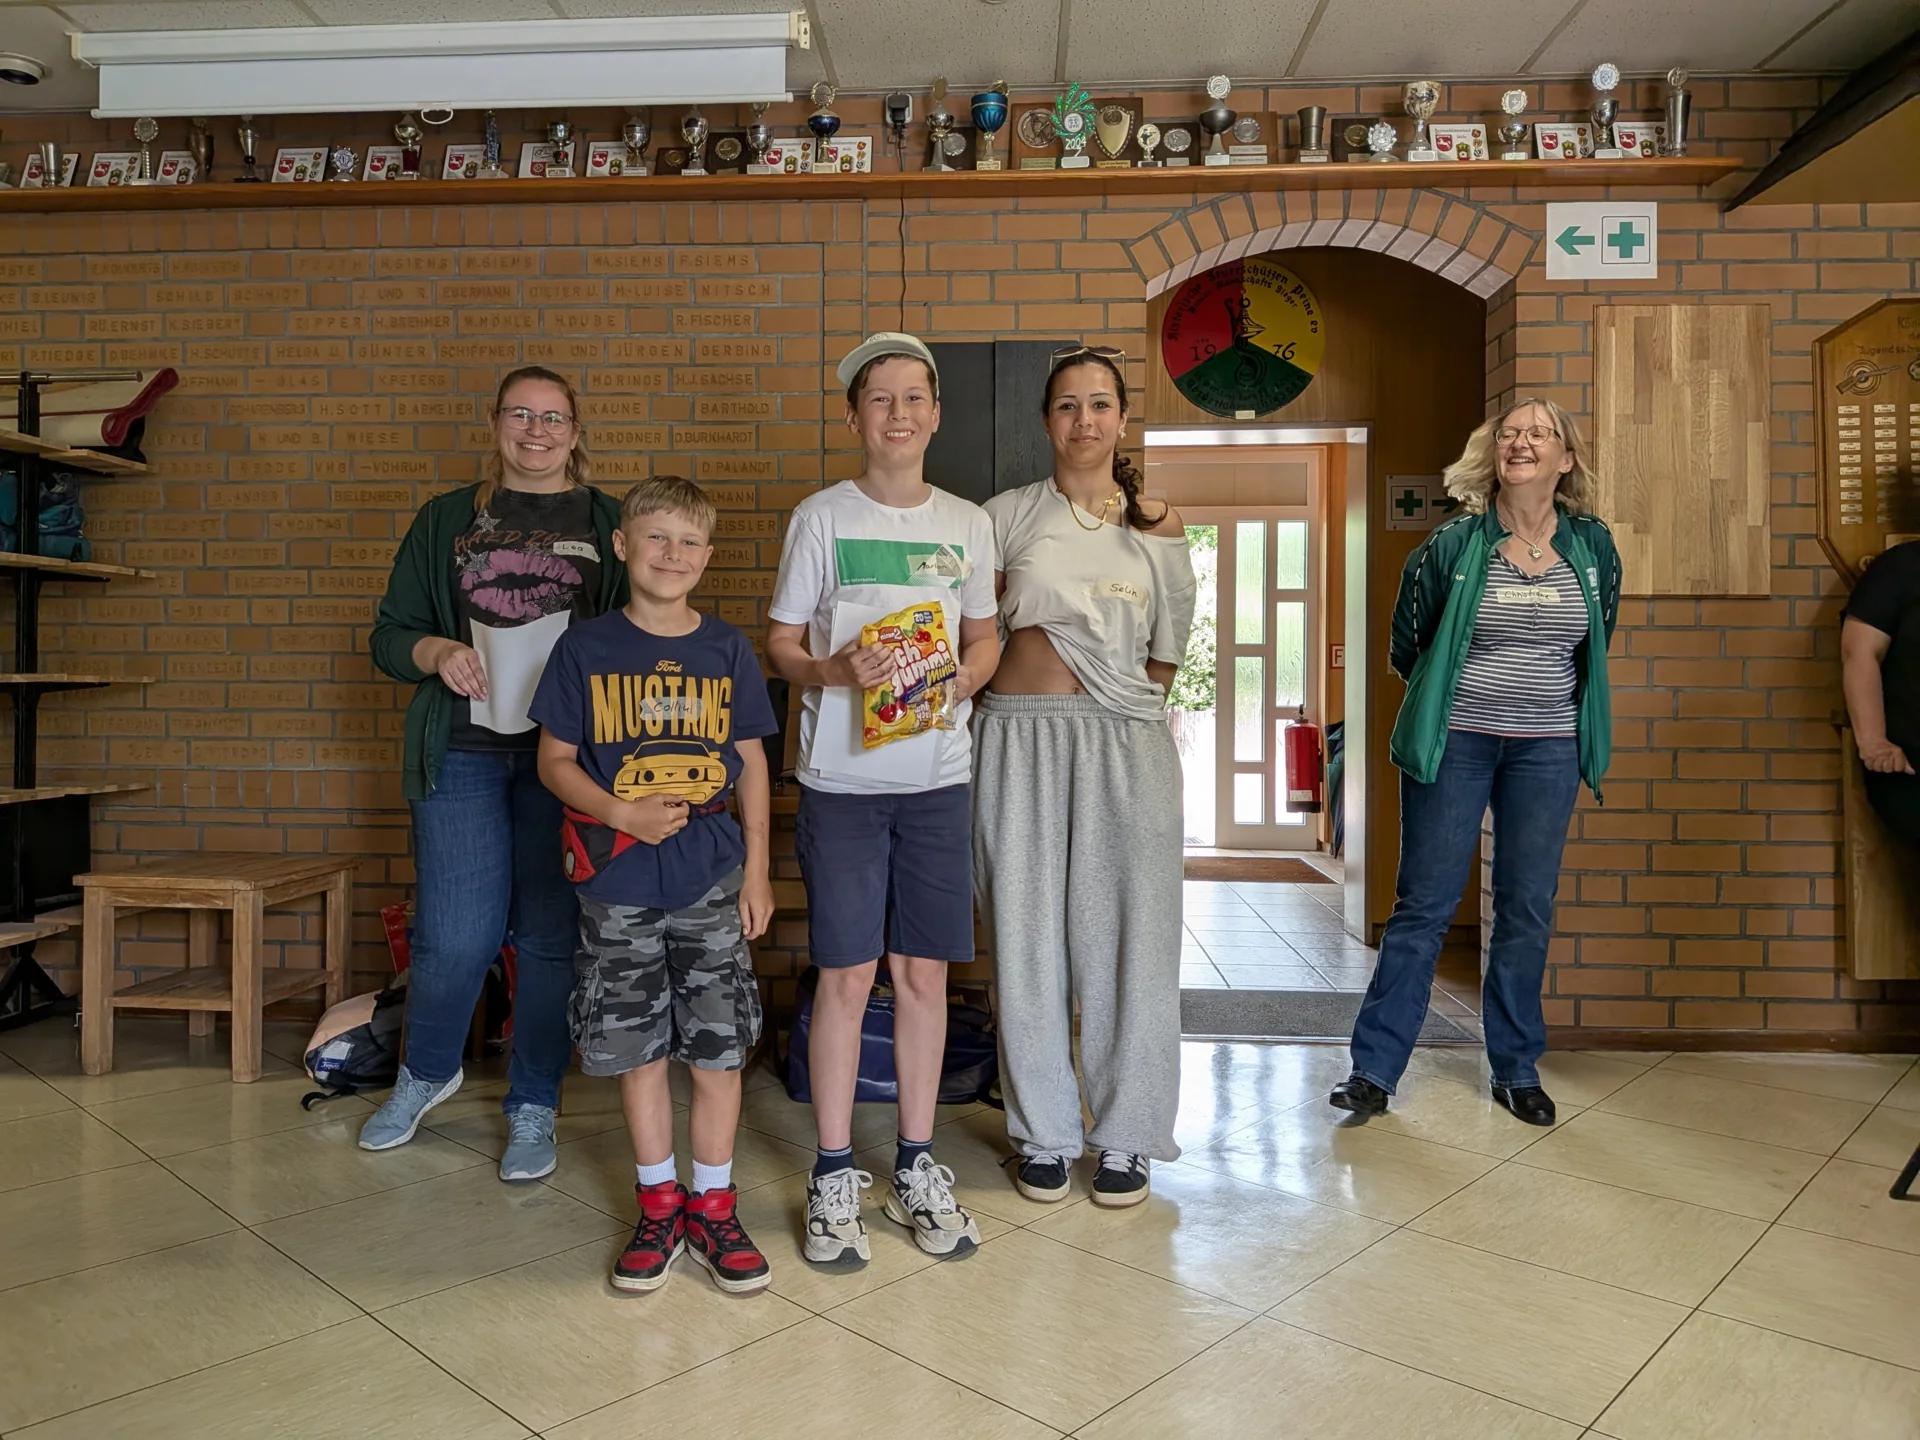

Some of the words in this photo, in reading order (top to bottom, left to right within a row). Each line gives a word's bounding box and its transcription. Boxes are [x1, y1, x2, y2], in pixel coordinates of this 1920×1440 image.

[1065, 136, 1087, 151] 2004
[680, 254, 749, 267] F.SIEMS
[377, 288, 404, 300] UND
[701, 284, 771, 297] NITSCH
[676, 314, 752, 328] R.FISCHER
[358, 342, 426, 358] GÜNTER
[440, 345, 516, 358] SCHIFFNER
[528, 344, 554, 358] EVA
[571, 344, 598, 357] UND
[615, 342, 684, 357] JÜRGEN
[701, 344, 772, 357] GERBING
[1190, 343, 1217, 362] 19
[1272, 341, 1298, 361] 76
[179, 376, 238, 390] OFFMANN
[675, 374, 753, 387] H.J.SACHSE
[320, 403, 381, 416] H.SOTT
[700, 402, 770, 414] BARTHOLD
[277, 433, 301, 445] UND
[346, 432, 399, 444] WIESE
[674, 431, 753, 444] D.BURKHARDT
[715, 519, 776, 532] EISSLER
[562, 543, 584, 552] Lea
[702, 574, 771, 590] JÖDICKE
[1109, 583, 1139, 598] Selin
[1504, 589, 1550, 601] Christiane
[654, 659, 683, 673] Ford
[590, 672, 732, 745] MUSTANG
